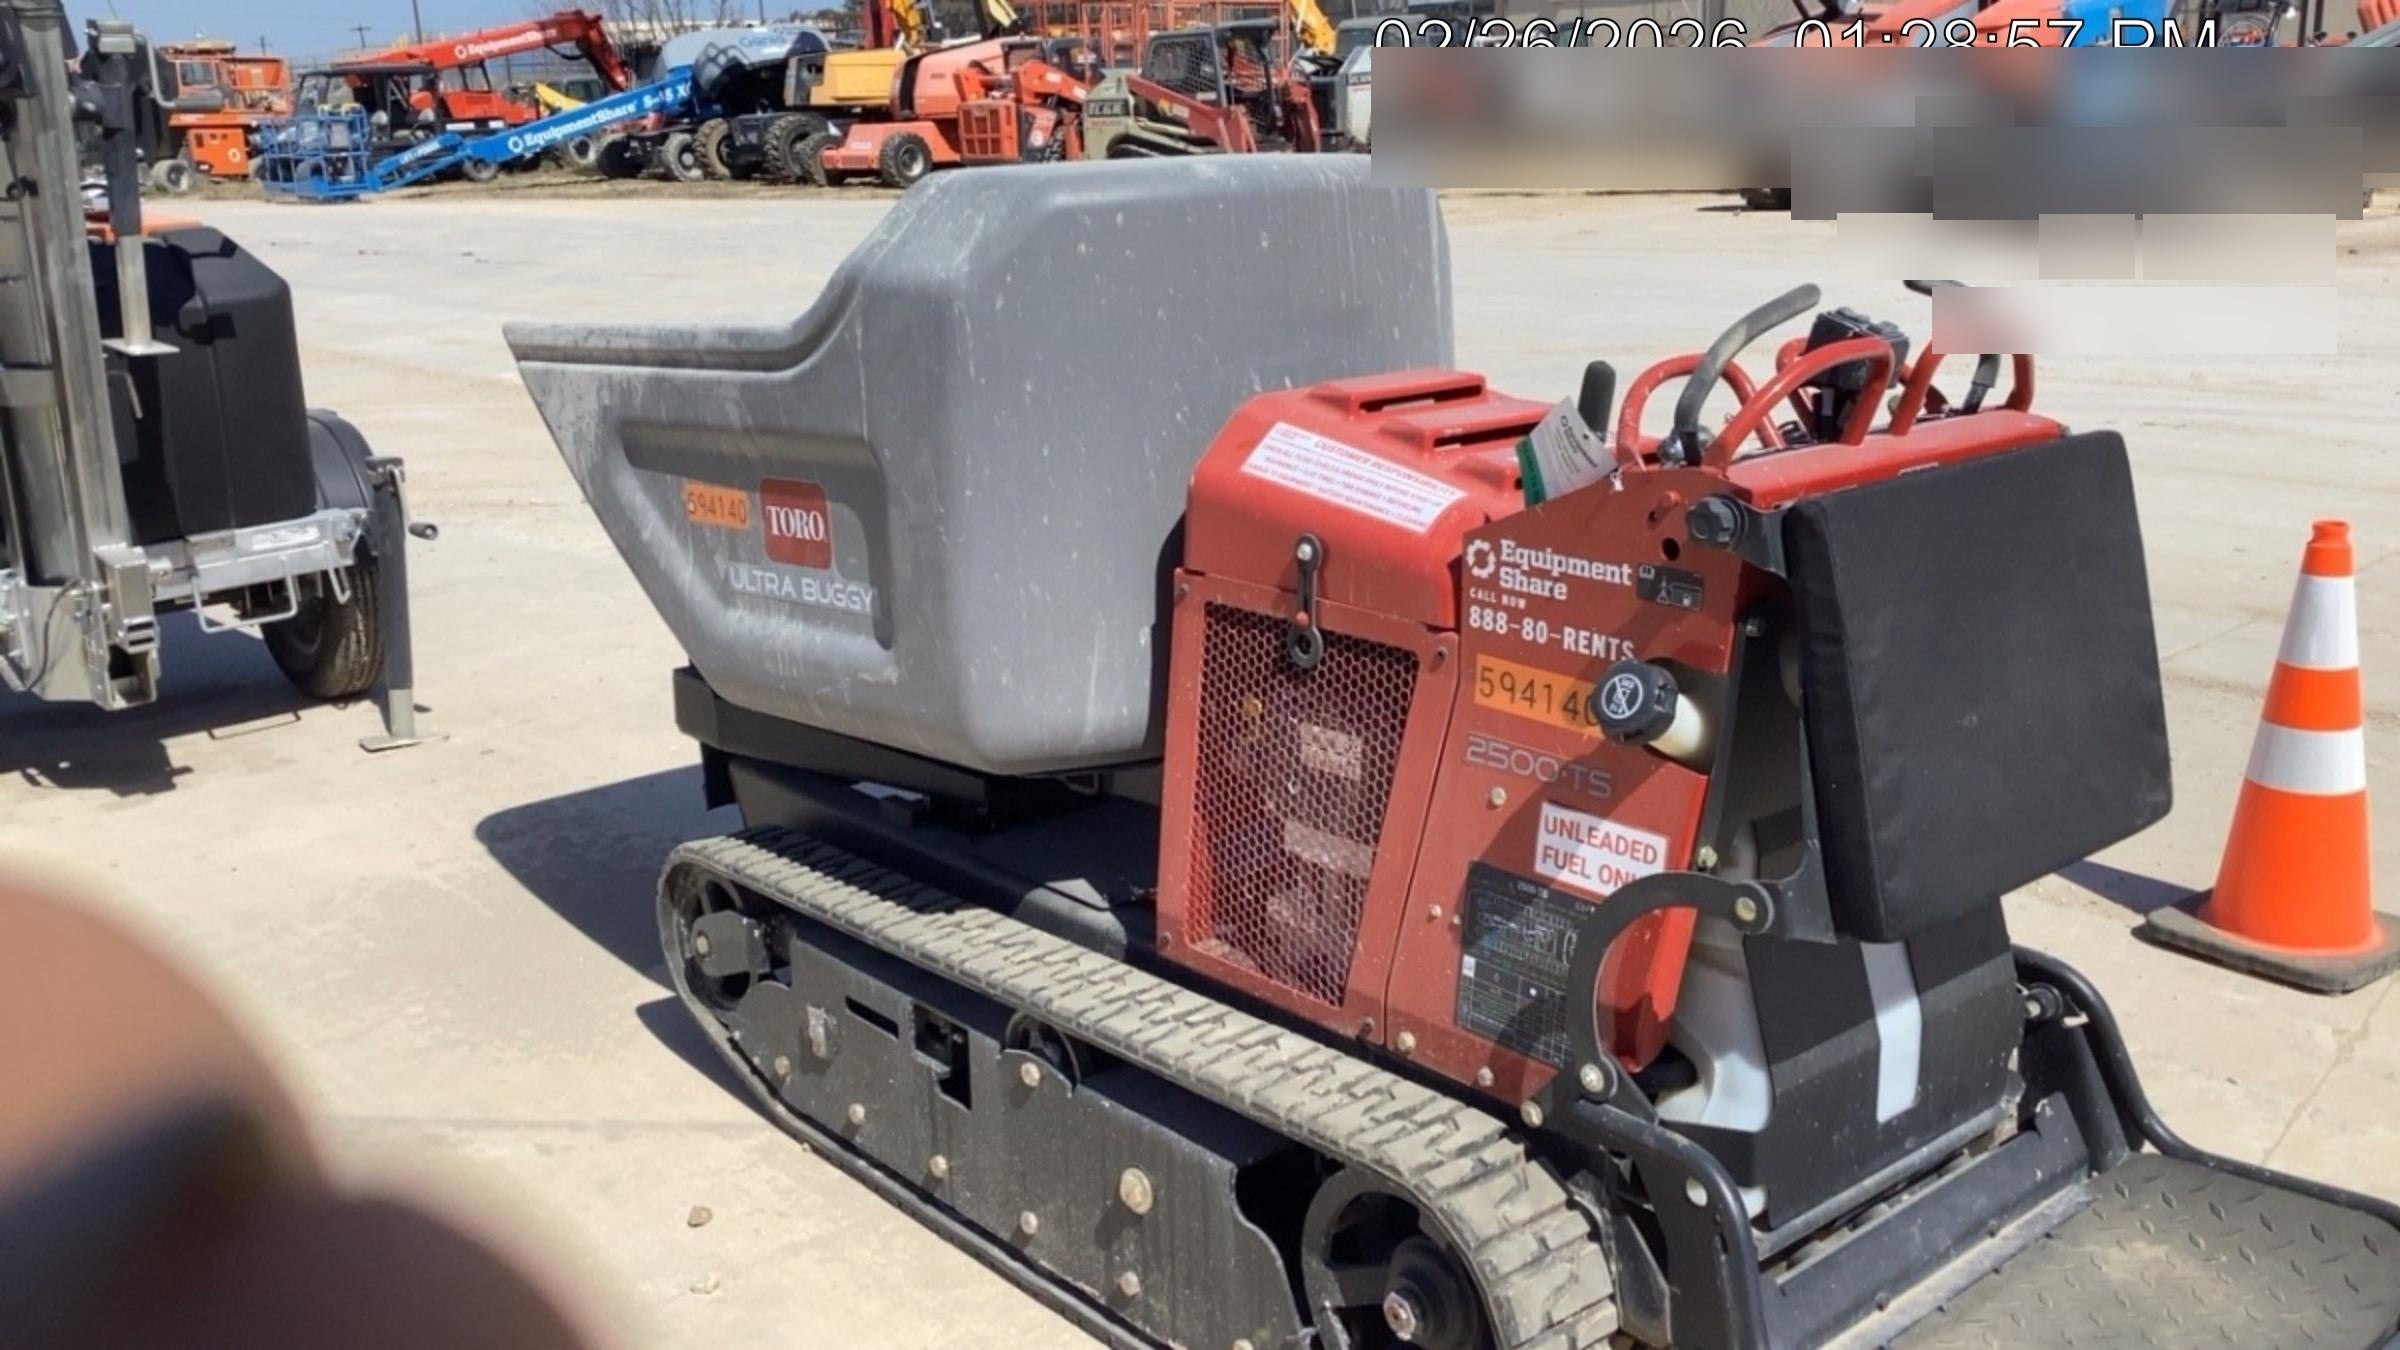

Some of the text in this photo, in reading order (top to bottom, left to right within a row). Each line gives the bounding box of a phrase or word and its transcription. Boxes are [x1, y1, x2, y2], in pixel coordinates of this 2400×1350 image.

[523, 103, 637, 146] EquipmentShare
[687, 492, 747, 523] 594140
[767, 506, 825, 540] TORO
[1499, 540, 1633, 586] Equipment
[1499, 568, 1568, 600] Share
[730, 567, 874, 612] ULTRA BUGGY
[1470, 588, 1527, 609] CALL NOW
[1469, 606, 1636, 661] 888-80-RENTS
[1544, 815, 1657, 865] UNLEADED
[1542, 846, 1640, 887] FUEL ON
